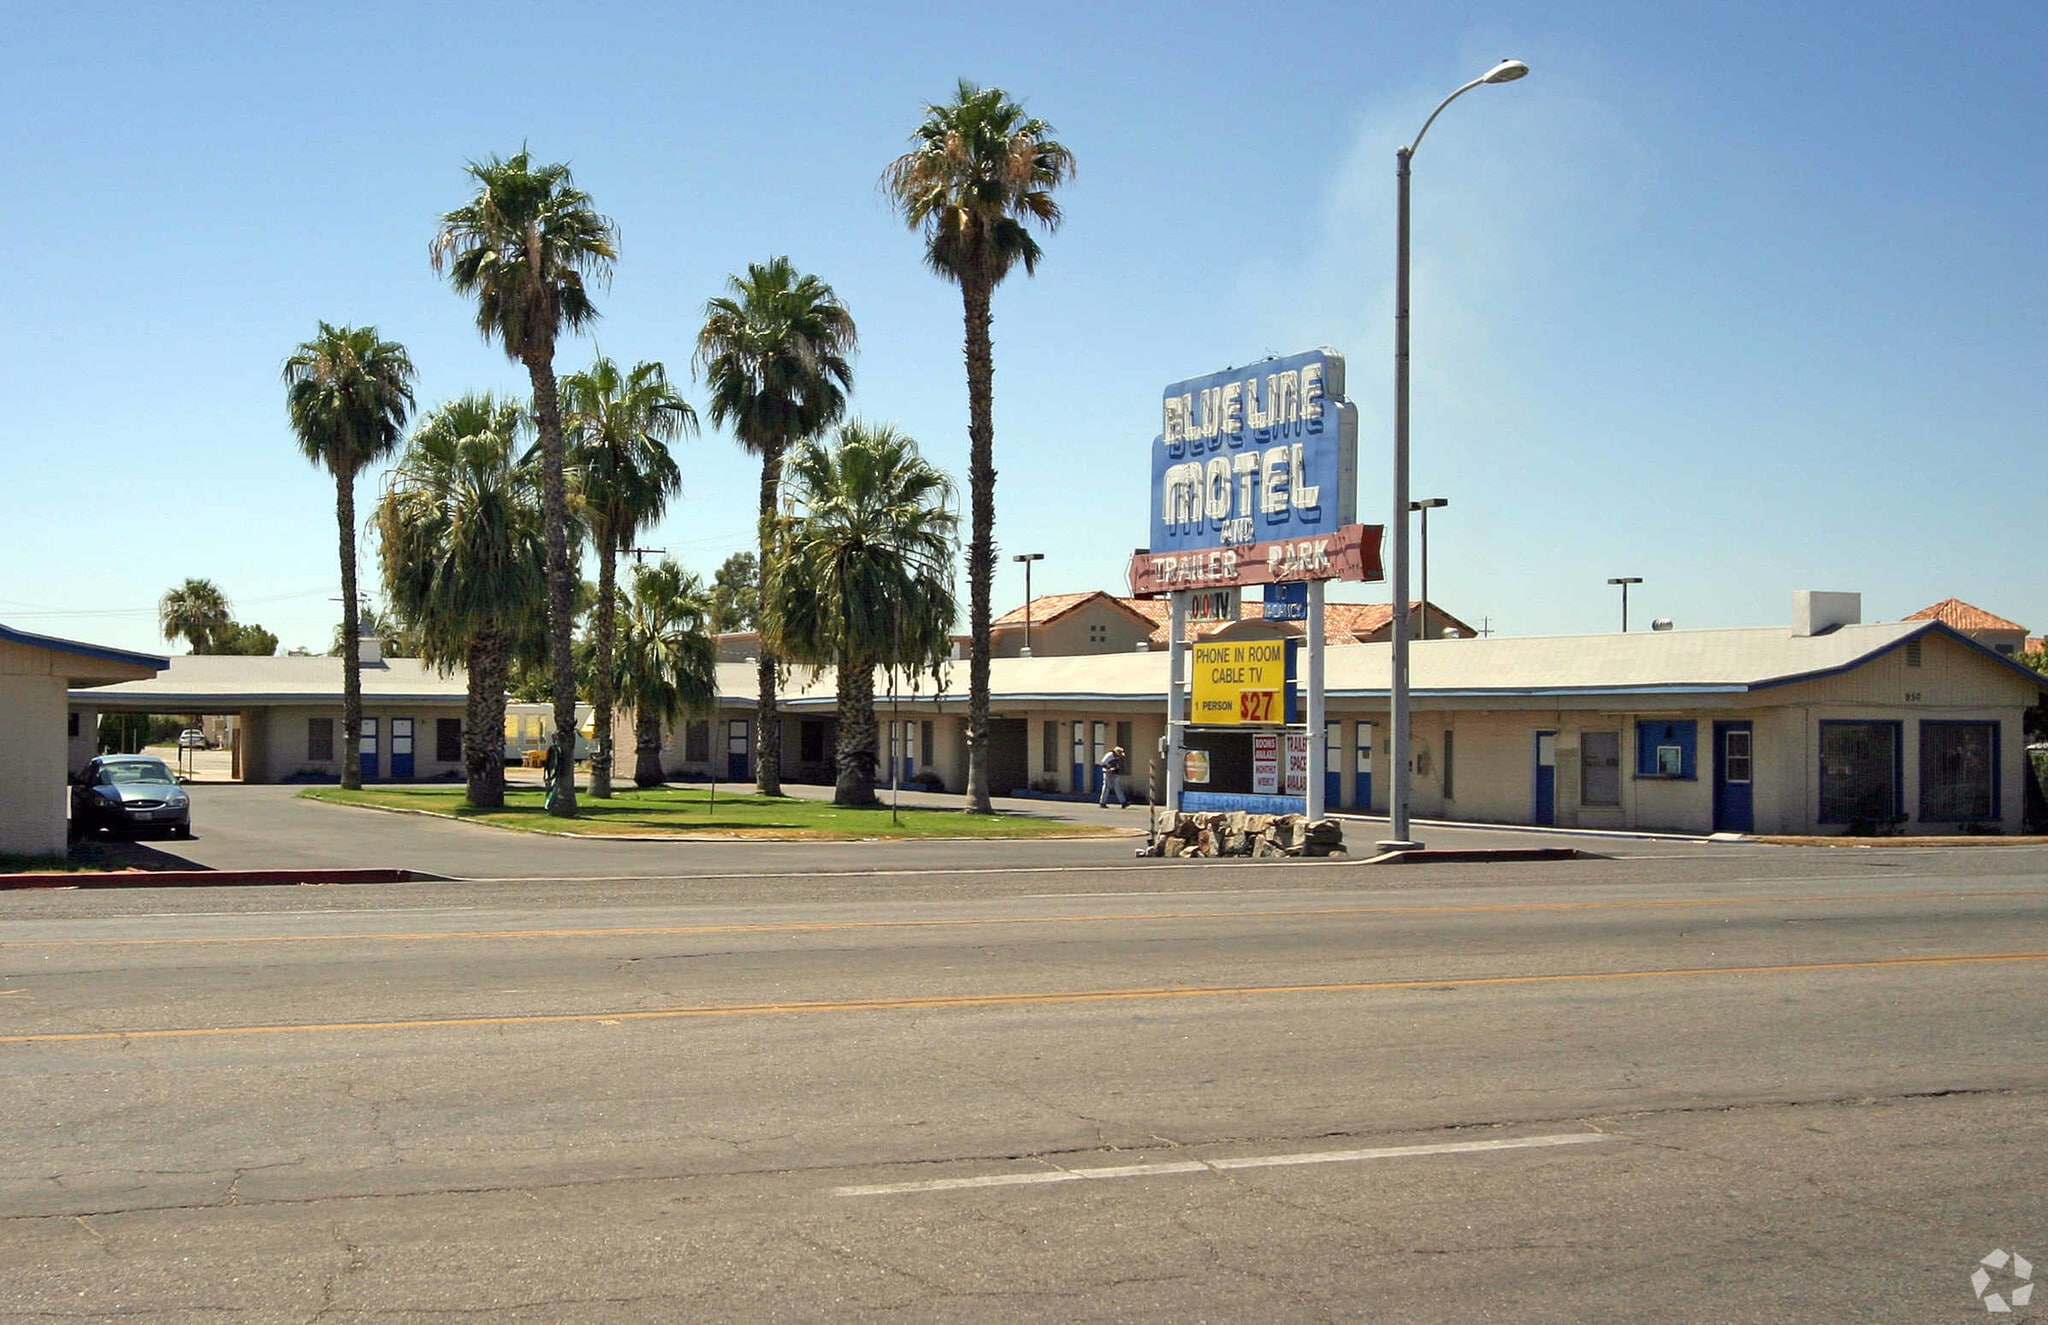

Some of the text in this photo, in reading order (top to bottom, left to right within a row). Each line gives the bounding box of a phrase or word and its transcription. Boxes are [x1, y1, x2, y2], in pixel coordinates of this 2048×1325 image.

[1162, 362, 1323, 446] BLUE LINE
[1162, 443, 1321, 525] MOTEL
[1220, 517, 1254, 544] AND
[1150, 539, 1332, 583] TRAILER PARK
[1196, 646, 1281, 664] PHONE IN ROOM
[1212, 667, 1263, 684] CABLE TV
[1202, 701, 1233, 712] PERSON
[1240, 691, 1274, 721] $27
[1287, 736, 1307, 753] TRAILE
